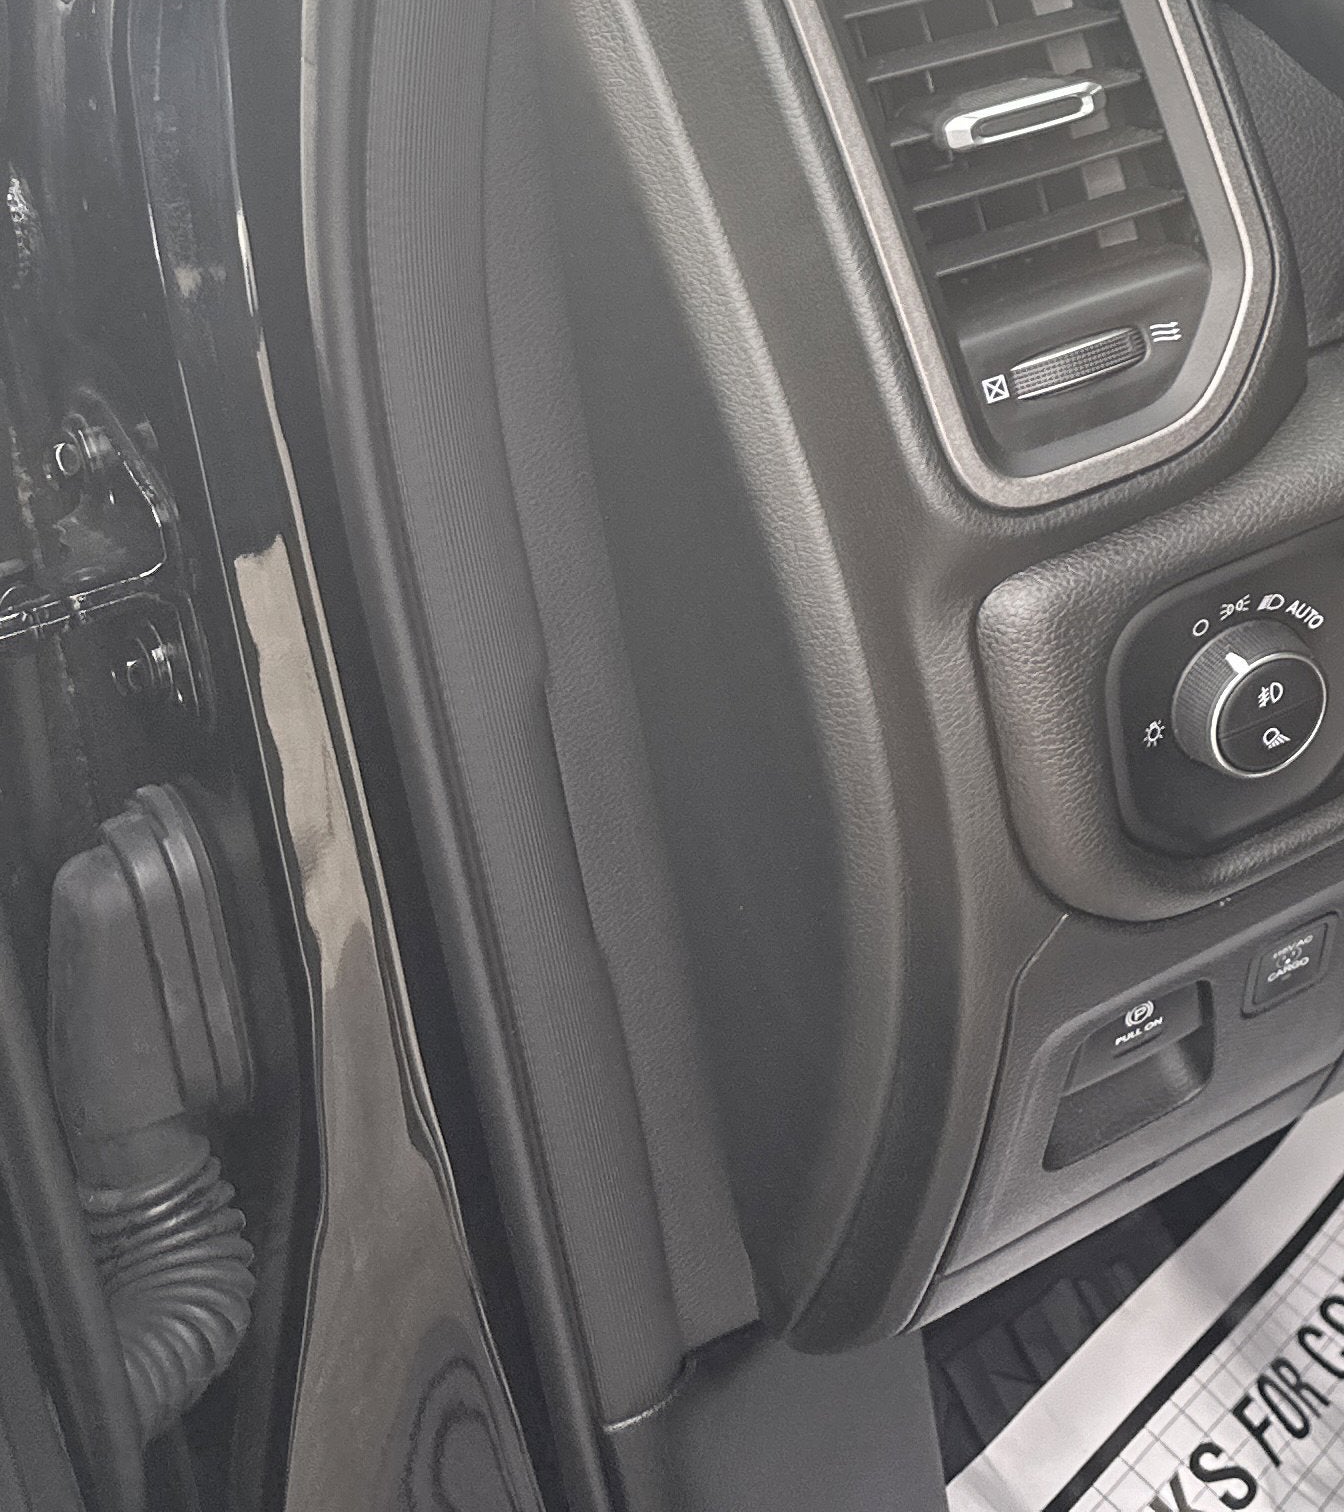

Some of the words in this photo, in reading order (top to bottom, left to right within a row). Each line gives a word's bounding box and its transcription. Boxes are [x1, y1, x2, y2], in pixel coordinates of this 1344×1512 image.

[1285, 599, 1325, 630] AUTO
[1267, 956, 1310, 982] CARGO
[1115, 1028, 1143, 1046] PULL
[1144, 1016, 1163, 1031] ON
[1231, 1356, 1330, 1468] FOR
